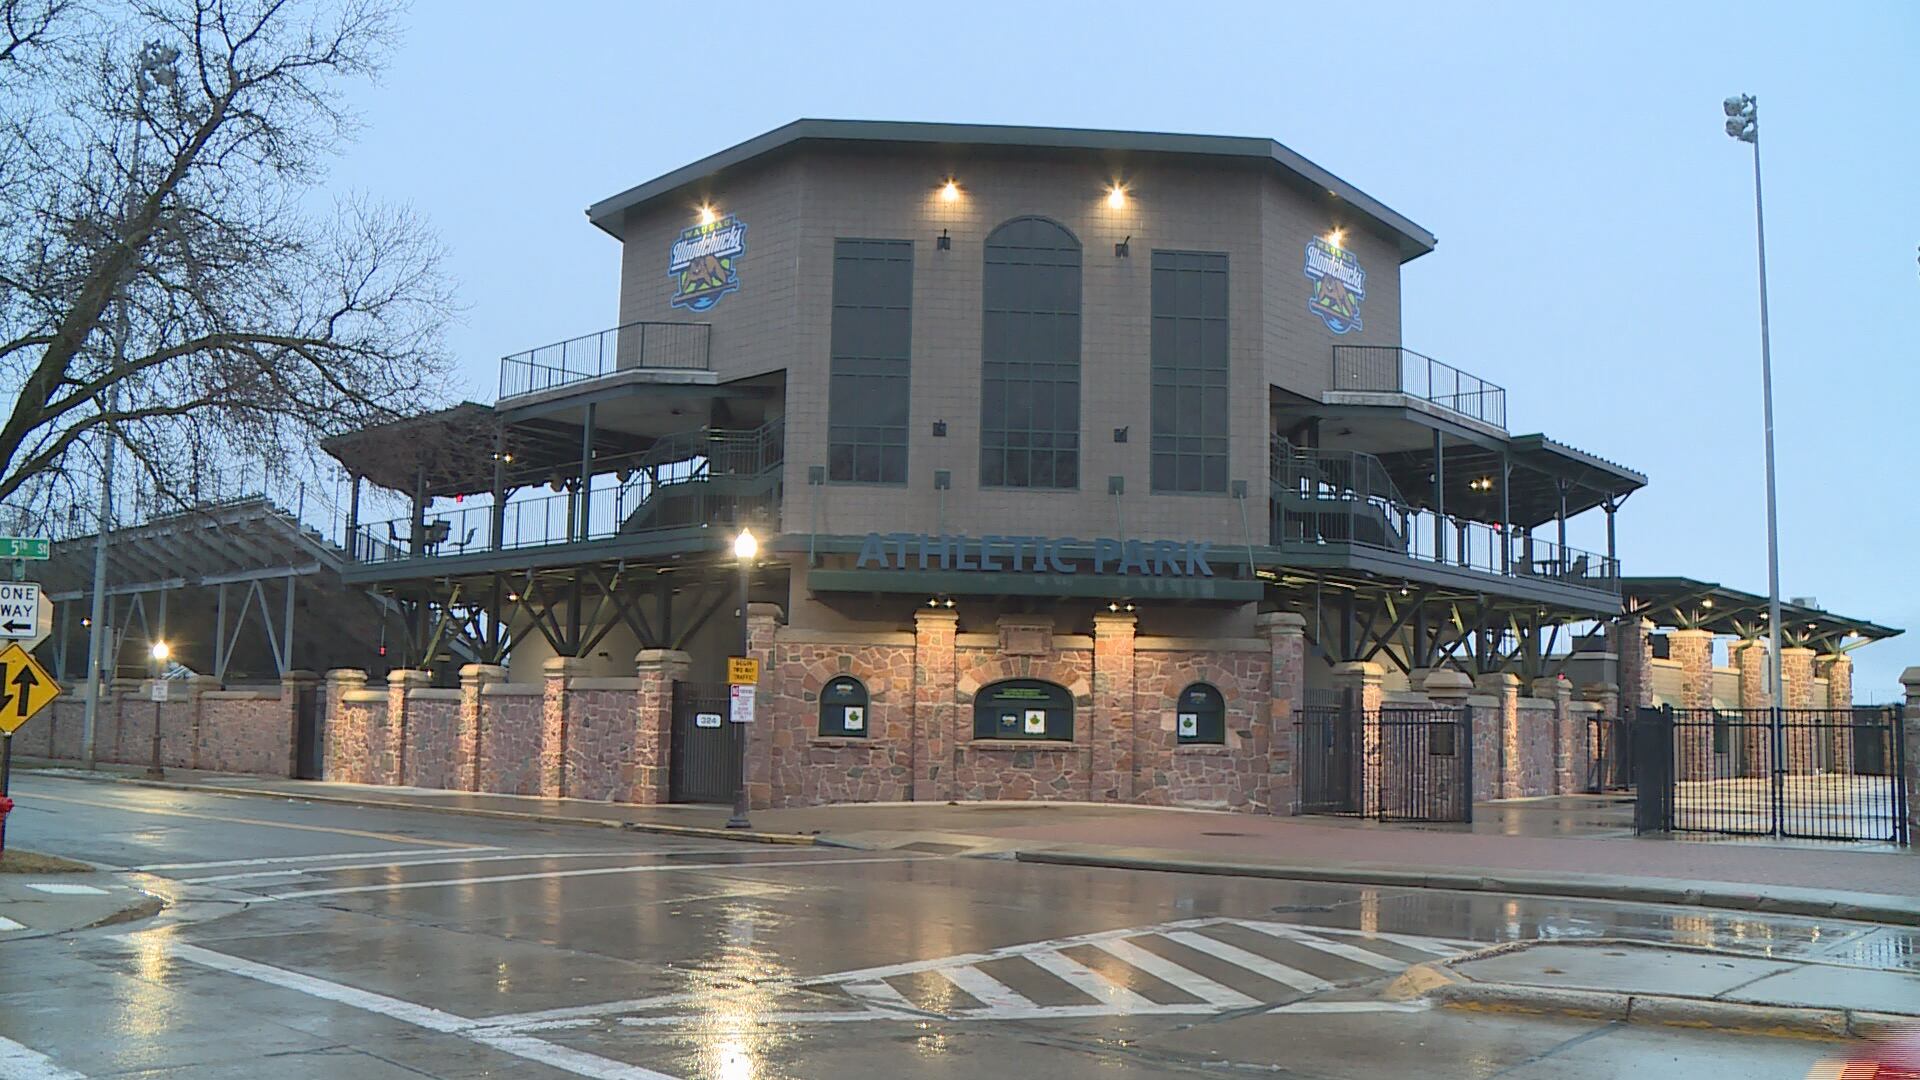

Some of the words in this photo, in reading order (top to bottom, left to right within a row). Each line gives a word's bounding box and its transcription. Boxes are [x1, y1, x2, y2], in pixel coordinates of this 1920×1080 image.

[672, 225, 743, 266] Woodchucks
[1307, 246, 1363, 289] Woodchucks
[37, 543, 47, 555] St
[856, 532, 1077, 574] ATHLETIC
[1094, 538, 1214, 577] PARK
[1, 587, 34, 601] ONE
[0, 604, 33, 617] WAY
